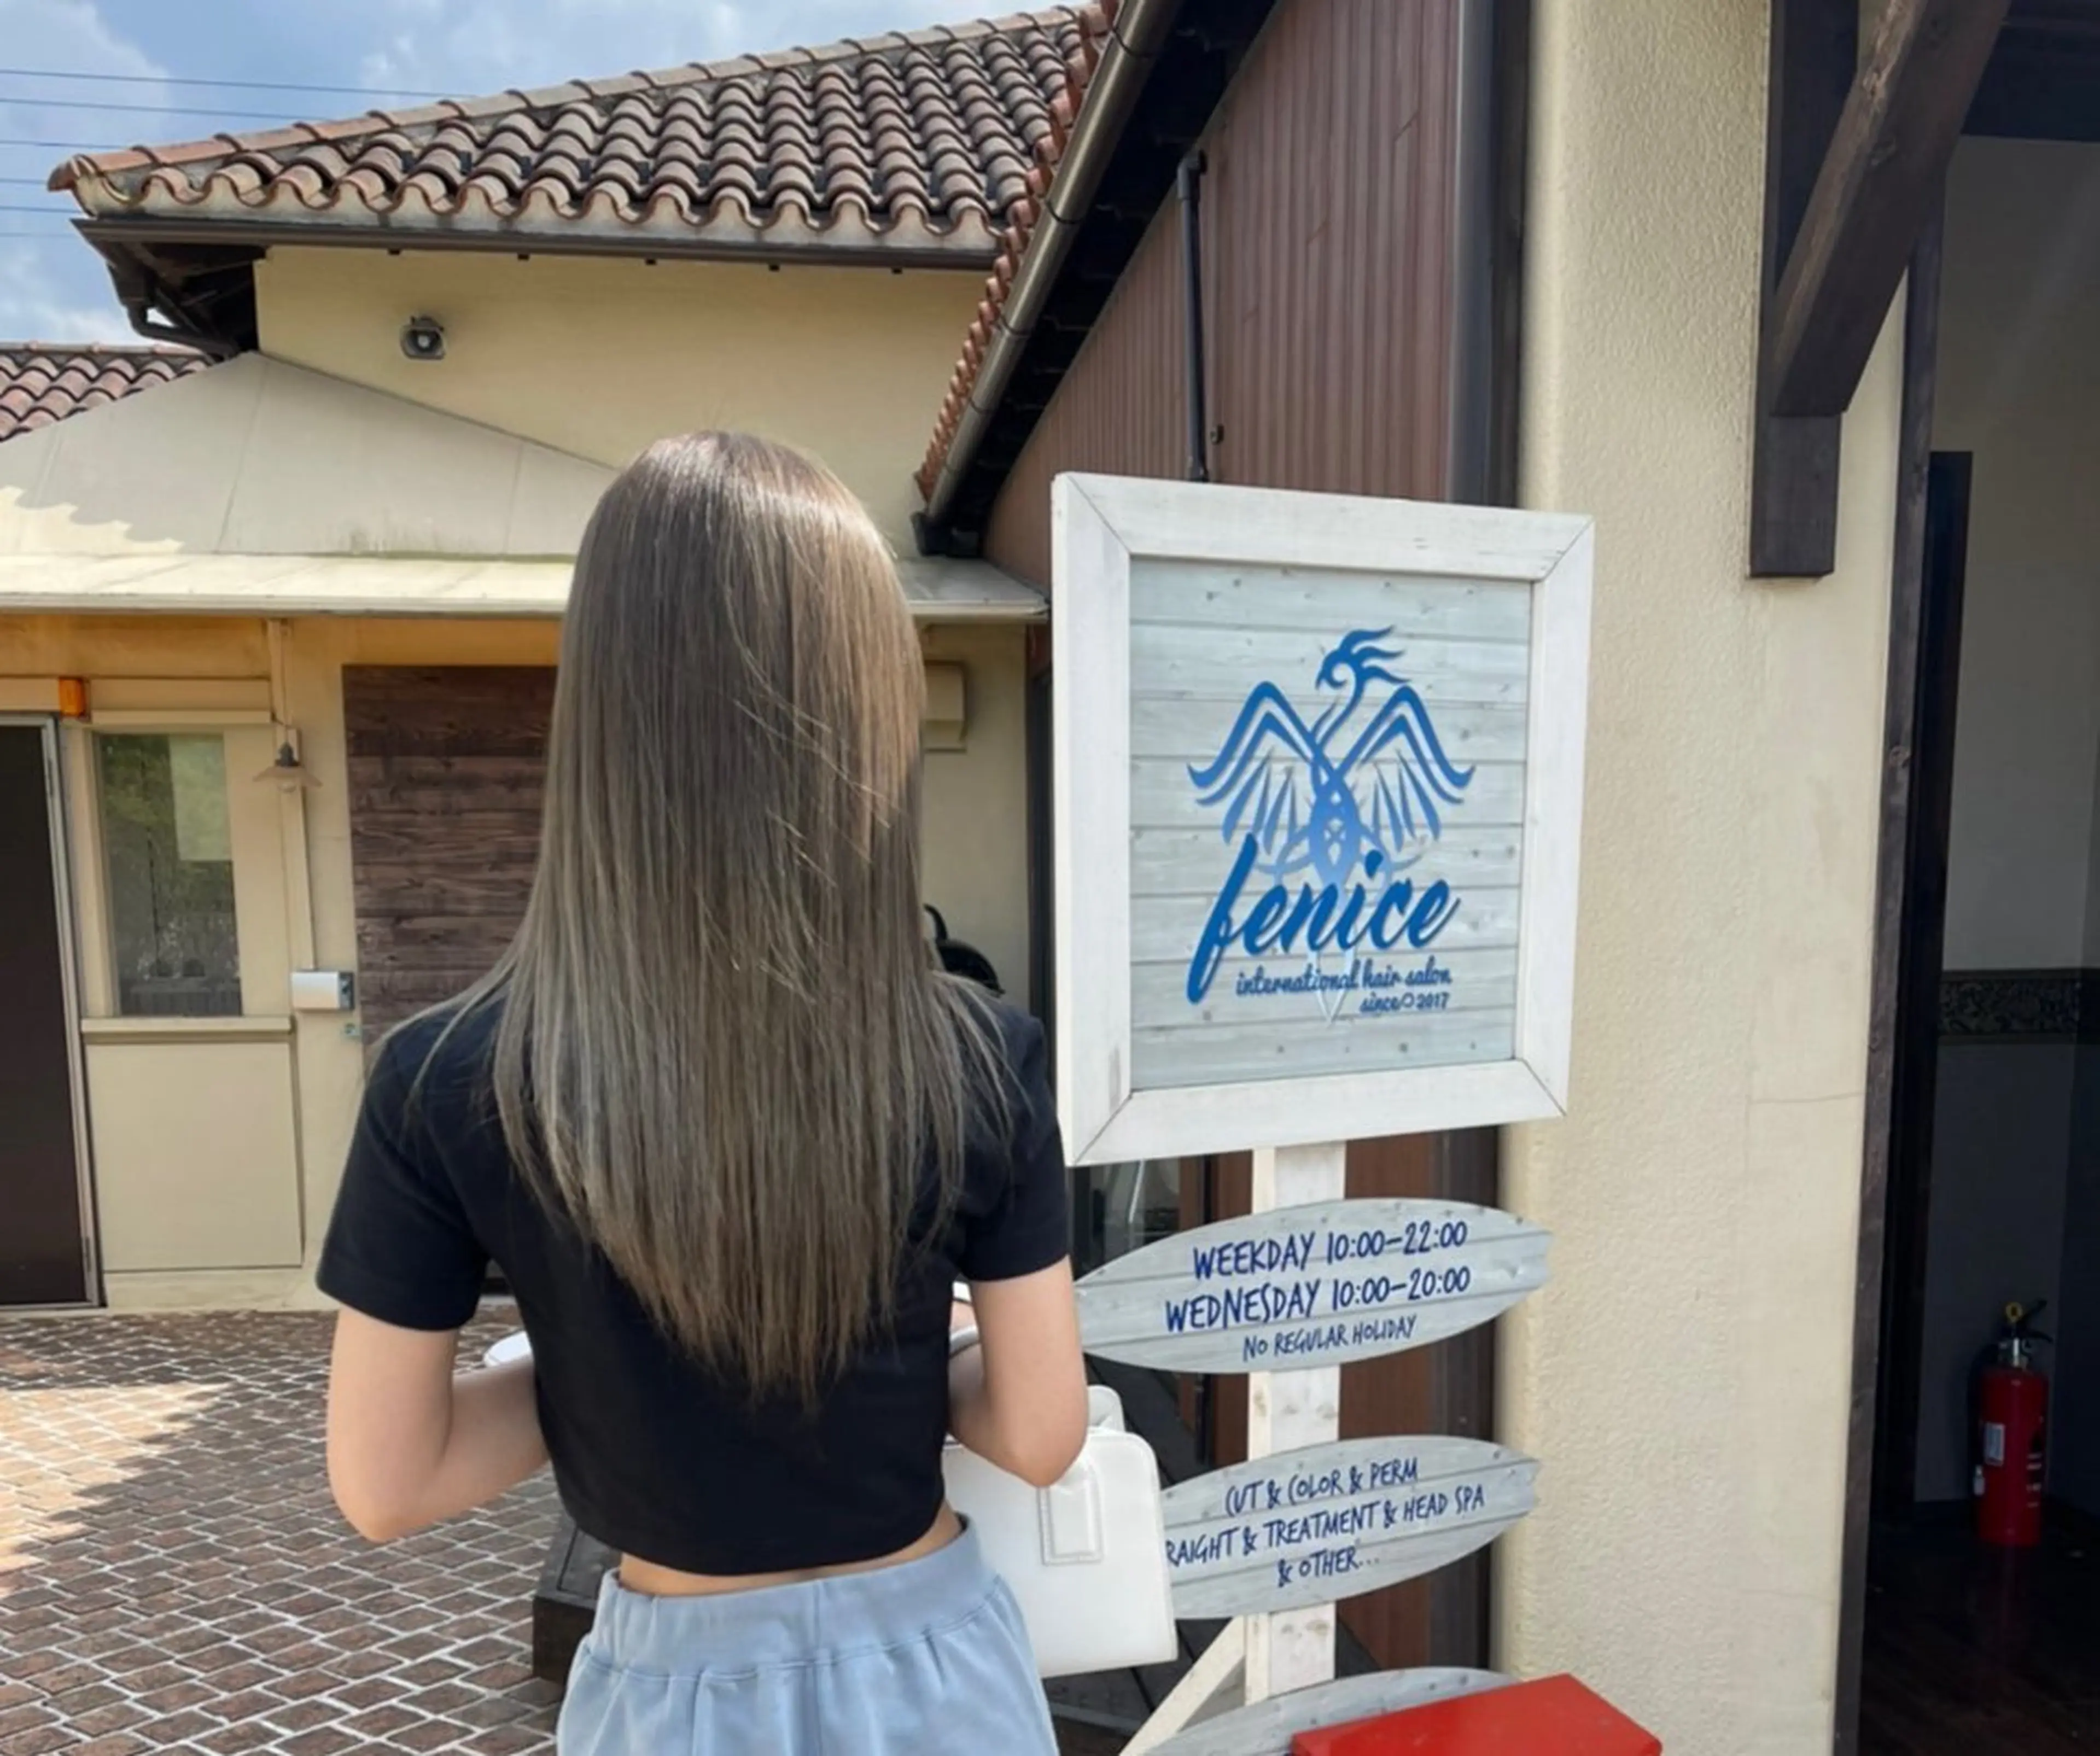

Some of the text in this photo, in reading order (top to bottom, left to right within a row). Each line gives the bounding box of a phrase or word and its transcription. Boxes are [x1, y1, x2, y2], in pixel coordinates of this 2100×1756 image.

[1187, 833, 1461, 1004] fenice
[1236, 955, 1452, 996] international hair salon
[1193, 1221, 1467, 1280] WEEKDAY 10:00-22:00
[1165, 1266, 1470, 1333] WEDNESDAY 10:00-20:00
[1274, 1323, 1349, 1357] REGULAR
[1352, 1315, 1418, 1344] HOLIDAY
[1226, 1457, 1419, 1517] CUT & COLOR & PERM
[1165, 1484, 1485, 1566] RAIGHT & TREATMENT & HEAD SPA
[1278, 1559, 1292, 1588] &
